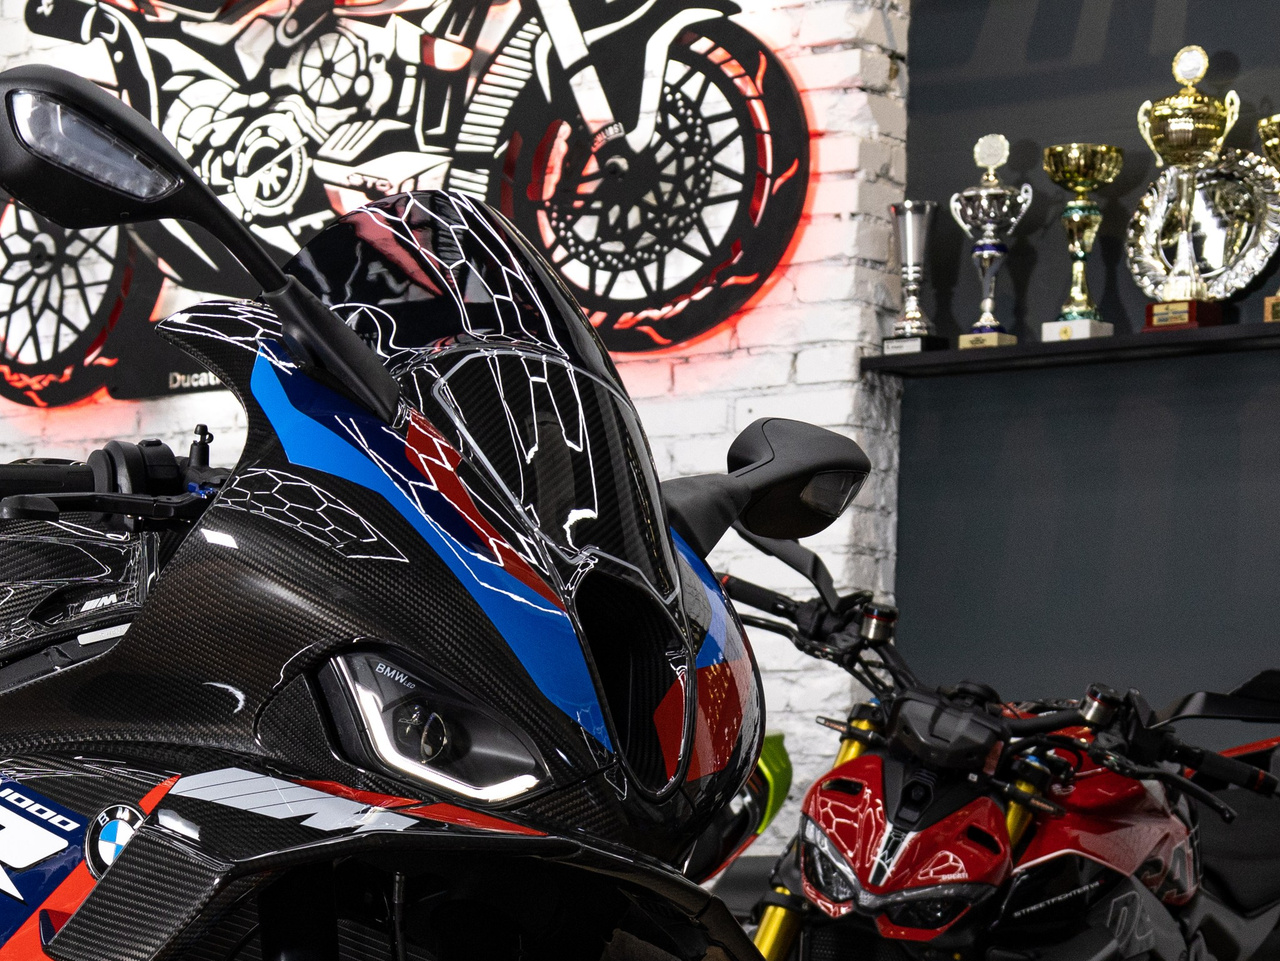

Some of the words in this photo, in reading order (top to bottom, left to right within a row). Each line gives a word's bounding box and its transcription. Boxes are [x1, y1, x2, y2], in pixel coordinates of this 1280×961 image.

[375, 663, 409, 683] BMW
[403, 680, 416, 689] LED
[1013, 884, 1089, 918] STREETFIGHTER
